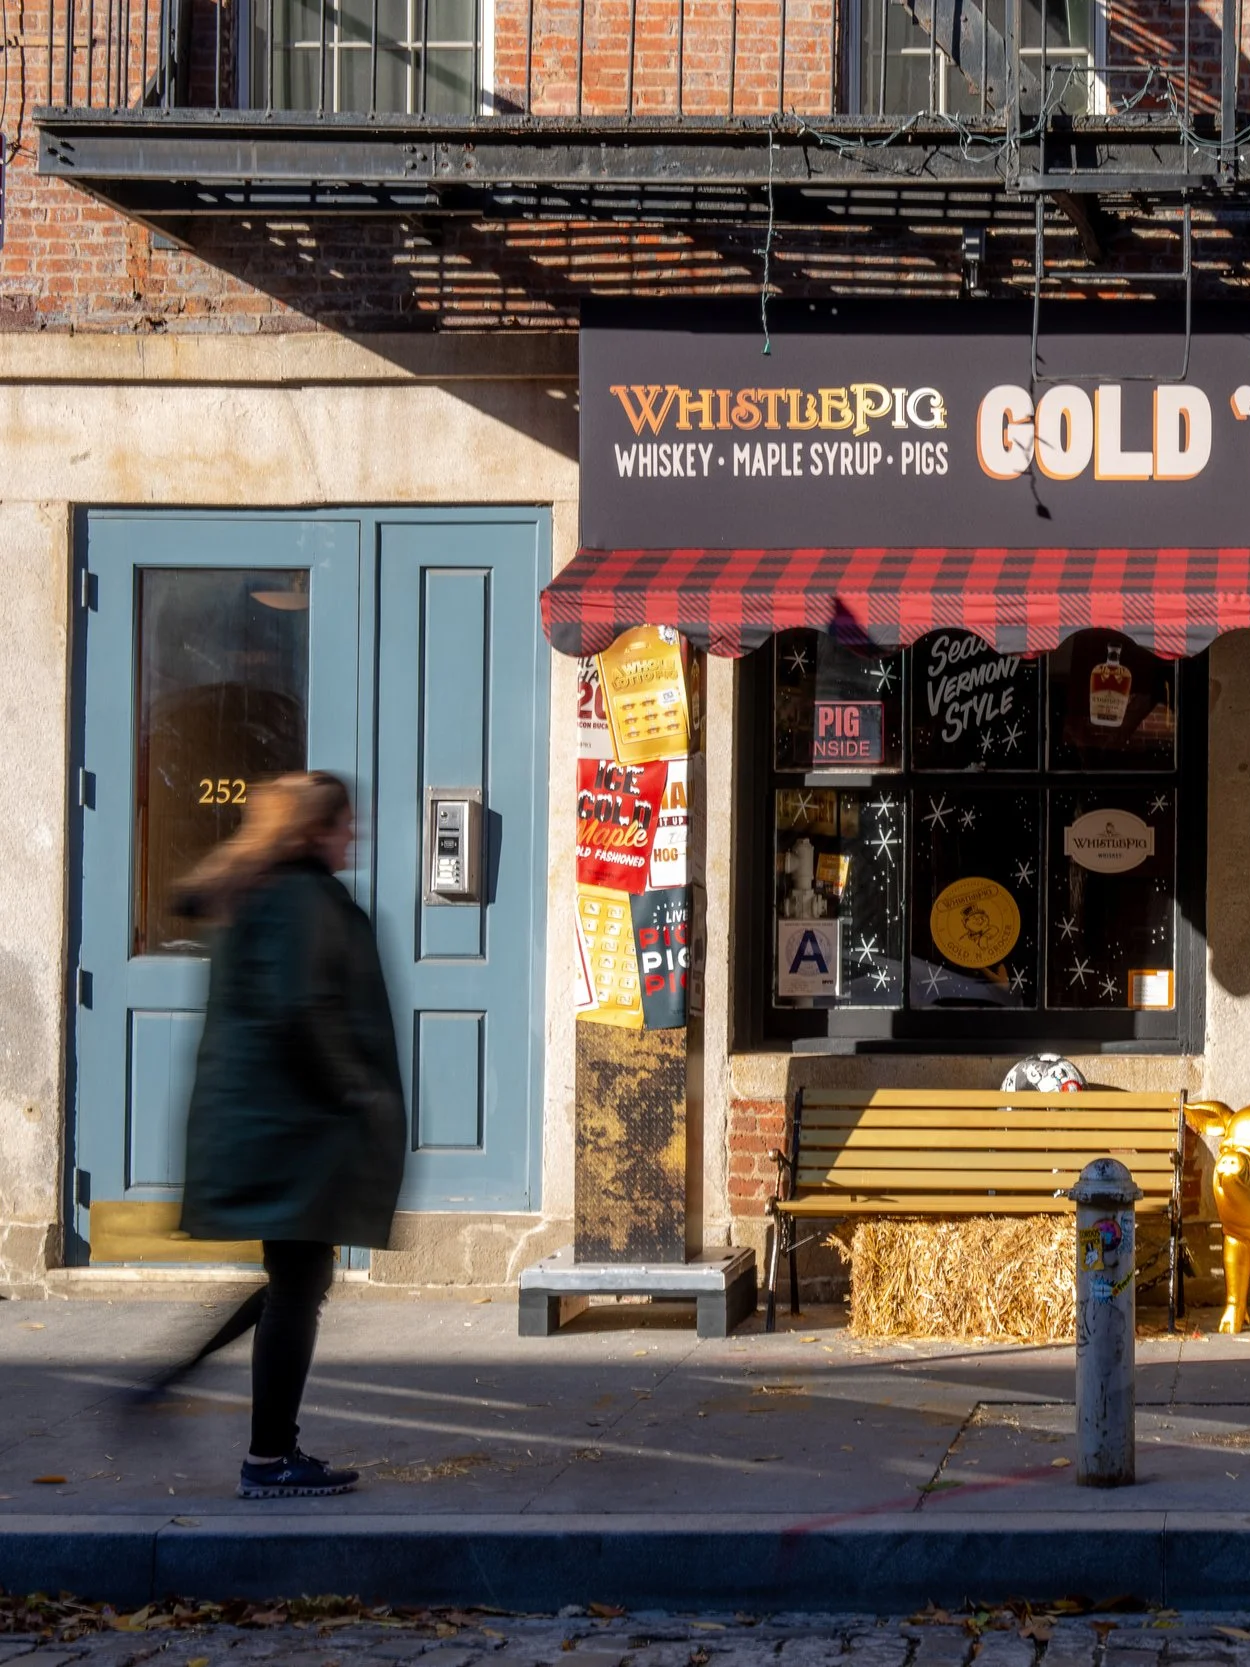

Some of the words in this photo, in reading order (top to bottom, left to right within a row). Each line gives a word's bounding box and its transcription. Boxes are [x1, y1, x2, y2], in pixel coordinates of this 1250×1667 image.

[977, 385, 1211, 481] GOLD
[615, 443, 714, 479] WHISKEY
[733, 441, 802, 478] MAPLE
[810, 441, 882, 477] SYRUP
[901, 440, 949, 476] PIGS
[927, 655, 1021, 717] VERMONT
[818, 706, 860, 737] PIG
[941, 686, 1014, 743] STYLE
[199, 778, 247, 804] 252
[594, 759, 645, 796] ICE
[577, 788, 652, 830] COLD
[594, 849, 645, 868] FASHIONED
[788, 929, 829, 974] A
